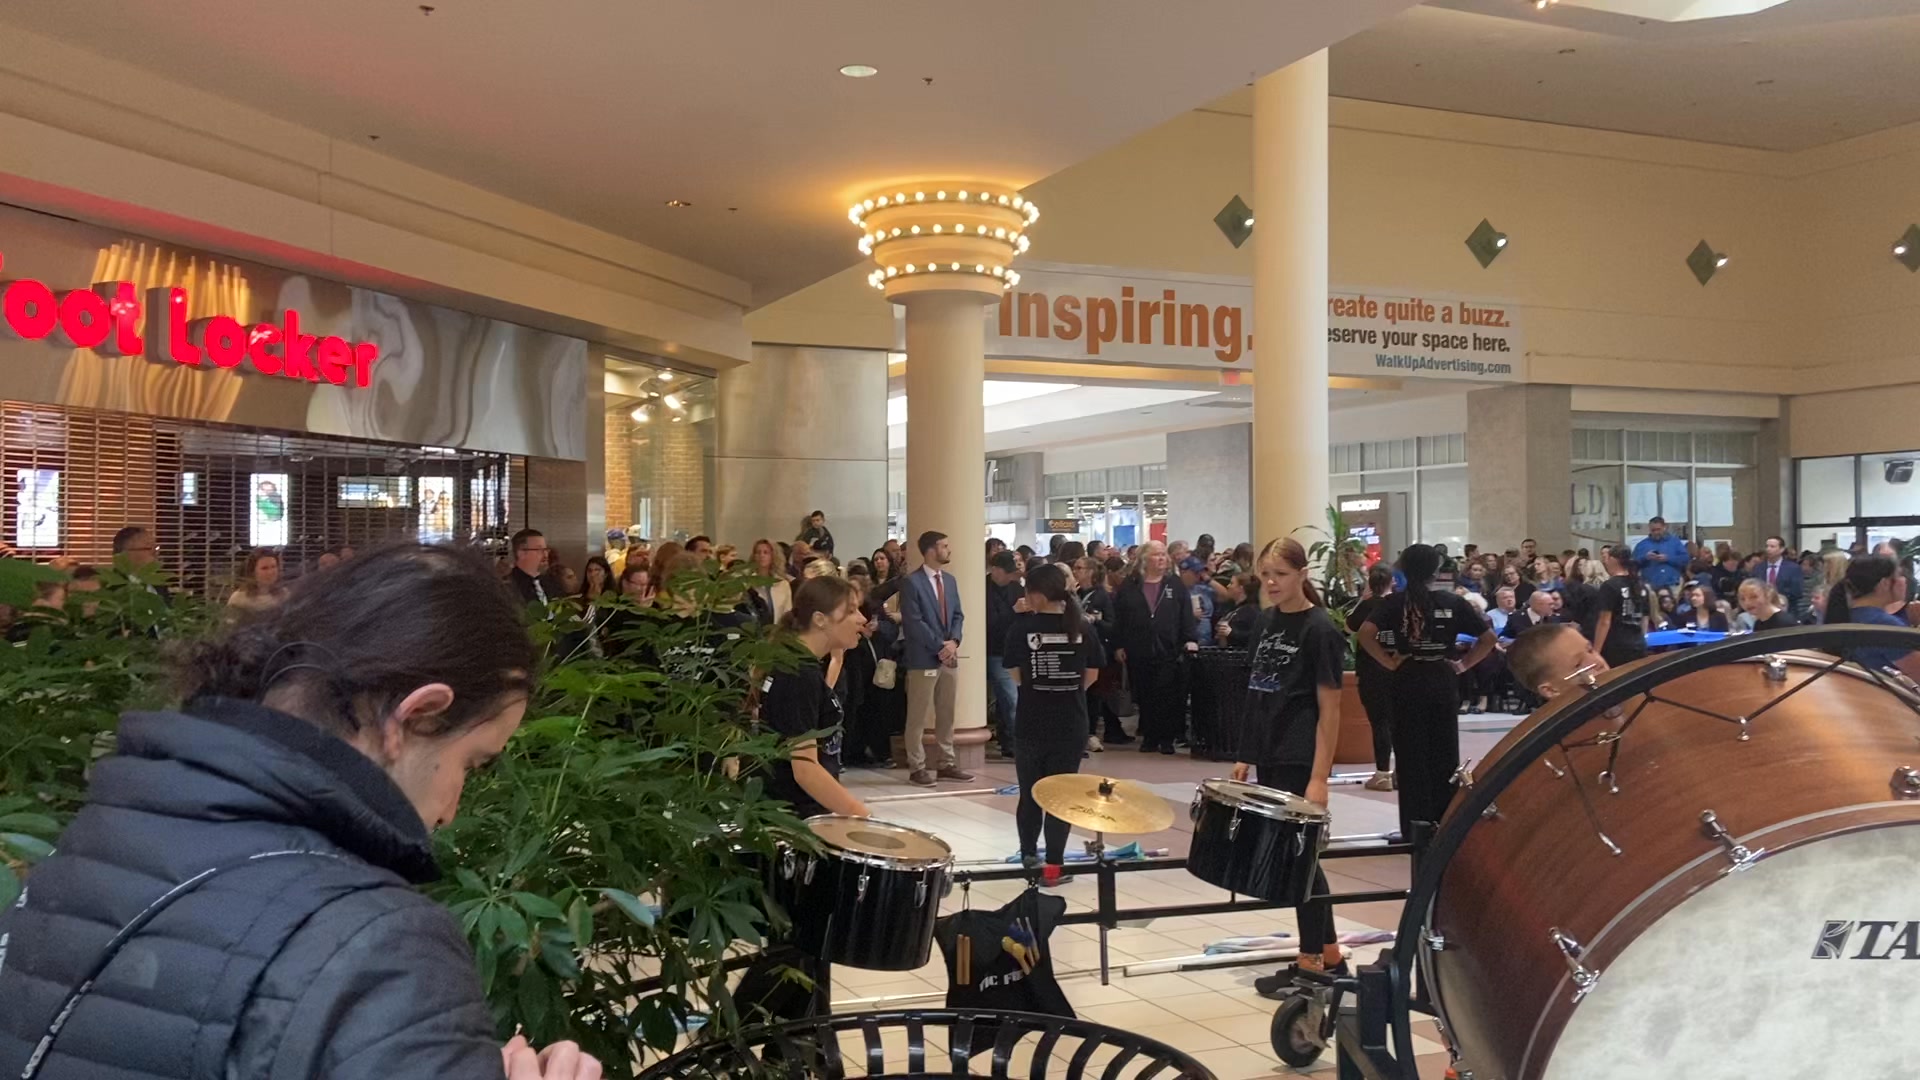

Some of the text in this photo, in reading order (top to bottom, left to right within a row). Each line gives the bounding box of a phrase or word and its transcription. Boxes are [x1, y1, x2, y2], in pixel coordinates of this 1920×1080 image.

[0, 253, 378, 388] oot Locker
[1328, 295, 1511, 327] reate quite a buzz.
[1382, 330, 1418, 349] your
[1422, 331, 1468, 351] space
[1473, 333, 1511, 352] here.
[1376, 354, 1511, 375] WalkUpAdvertising.com
